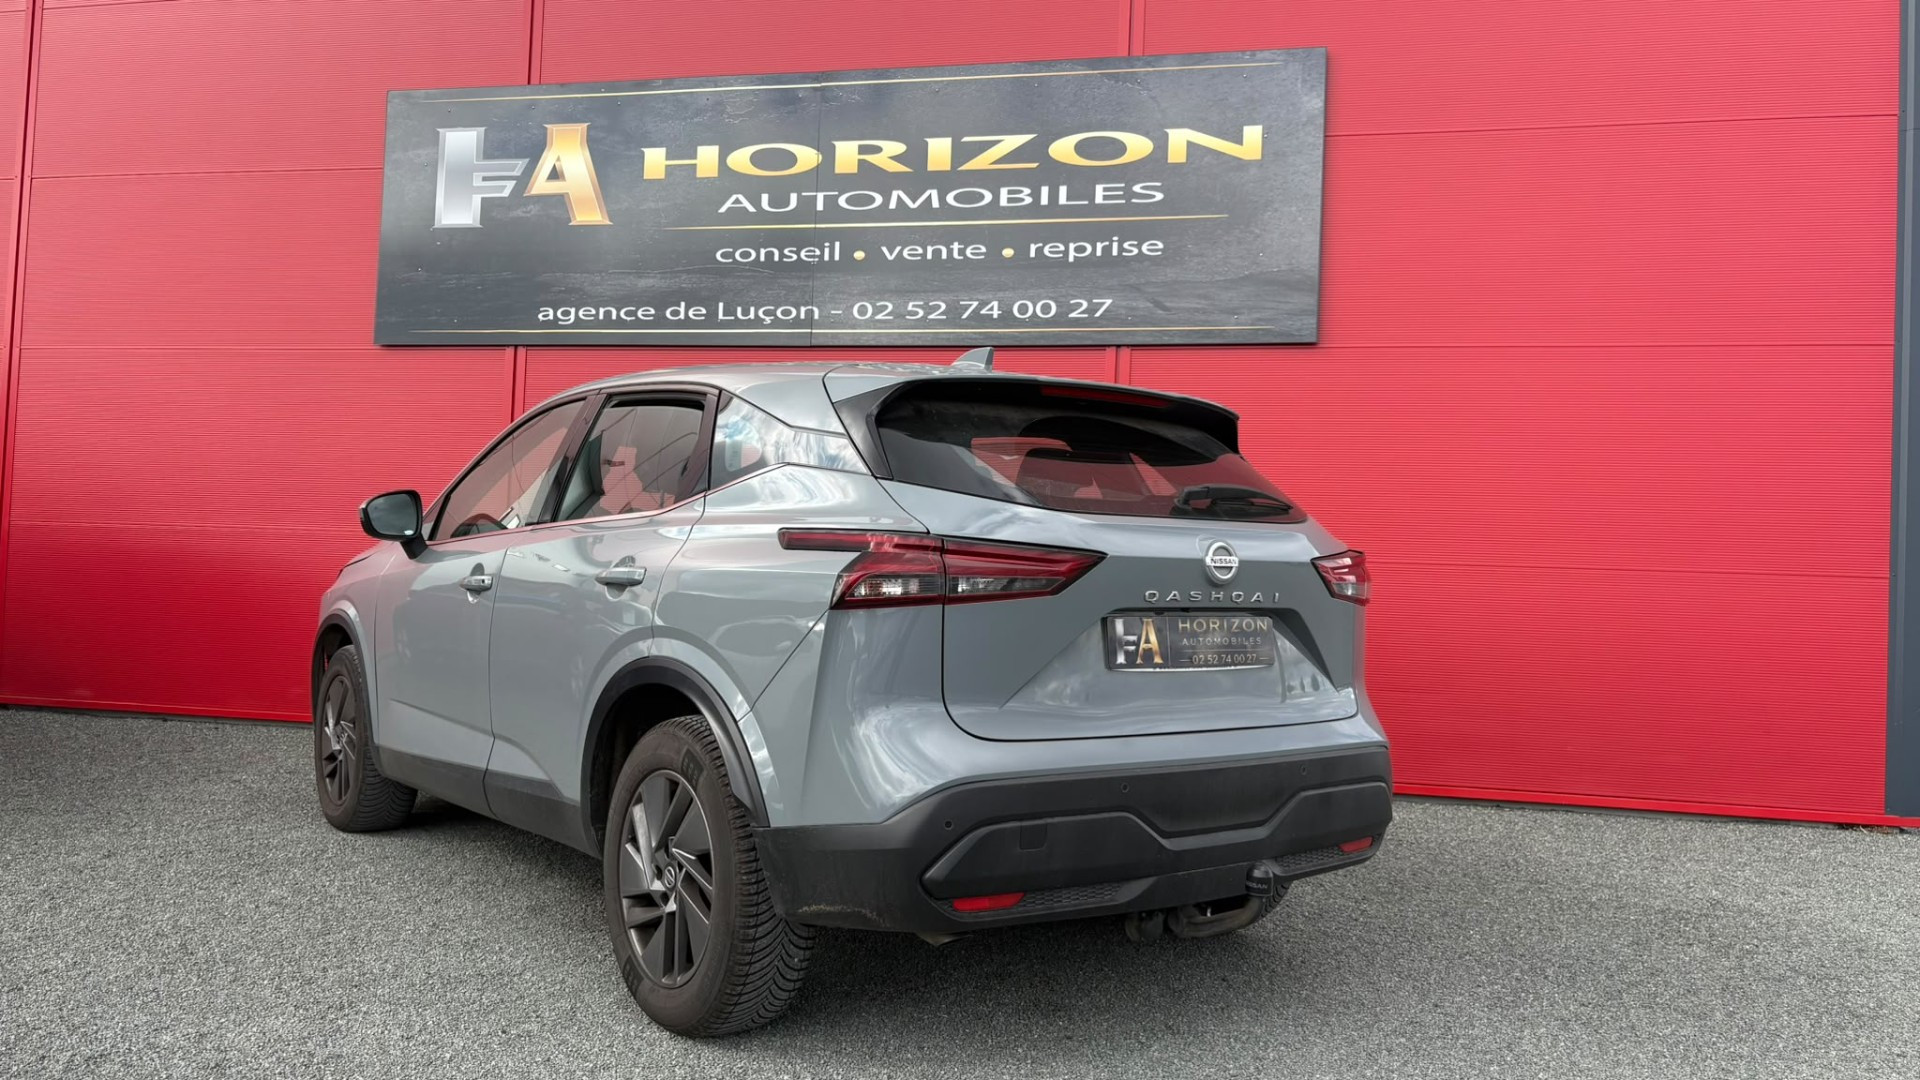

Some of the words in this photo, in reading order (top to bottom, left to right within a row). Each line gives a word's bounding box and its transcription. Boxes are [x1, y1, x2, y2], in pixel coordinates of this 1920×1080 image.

[642, 125, 1263, 179] HORIZON
[718, 182, 1165, 213] AUTOMOBILES
[715, 242, 840, 264] conseil
[881, 240, 987, 261] vente
[1029, 236, 1164, 263] reprise
[537, 306, 655, 324] agence
[665, 302, 707, 320] de
[718, 302, 819, 325] Luçon
[852, 302, 894, 320] 02
[905, 302, 947, 320] 52
[958, 301, 1002, 319] 74
[1012, 300, 1057, 318] 00
[1068, 299, 1113, 317] 27
[1144, 590, 1280, 604] QASHQAI
[1178, 619, 1268, 632] HORIZON
[1182, 637, 1262, 646] AUTOMOBILES
[1192, 655, 1205, 664] 02
[1207, 655, 1220, 664] 52
[1221, 655, 1232, 664] 74
[1234, 654, 1245, 663] 00
[1247, 654, 1257, 663] 27
